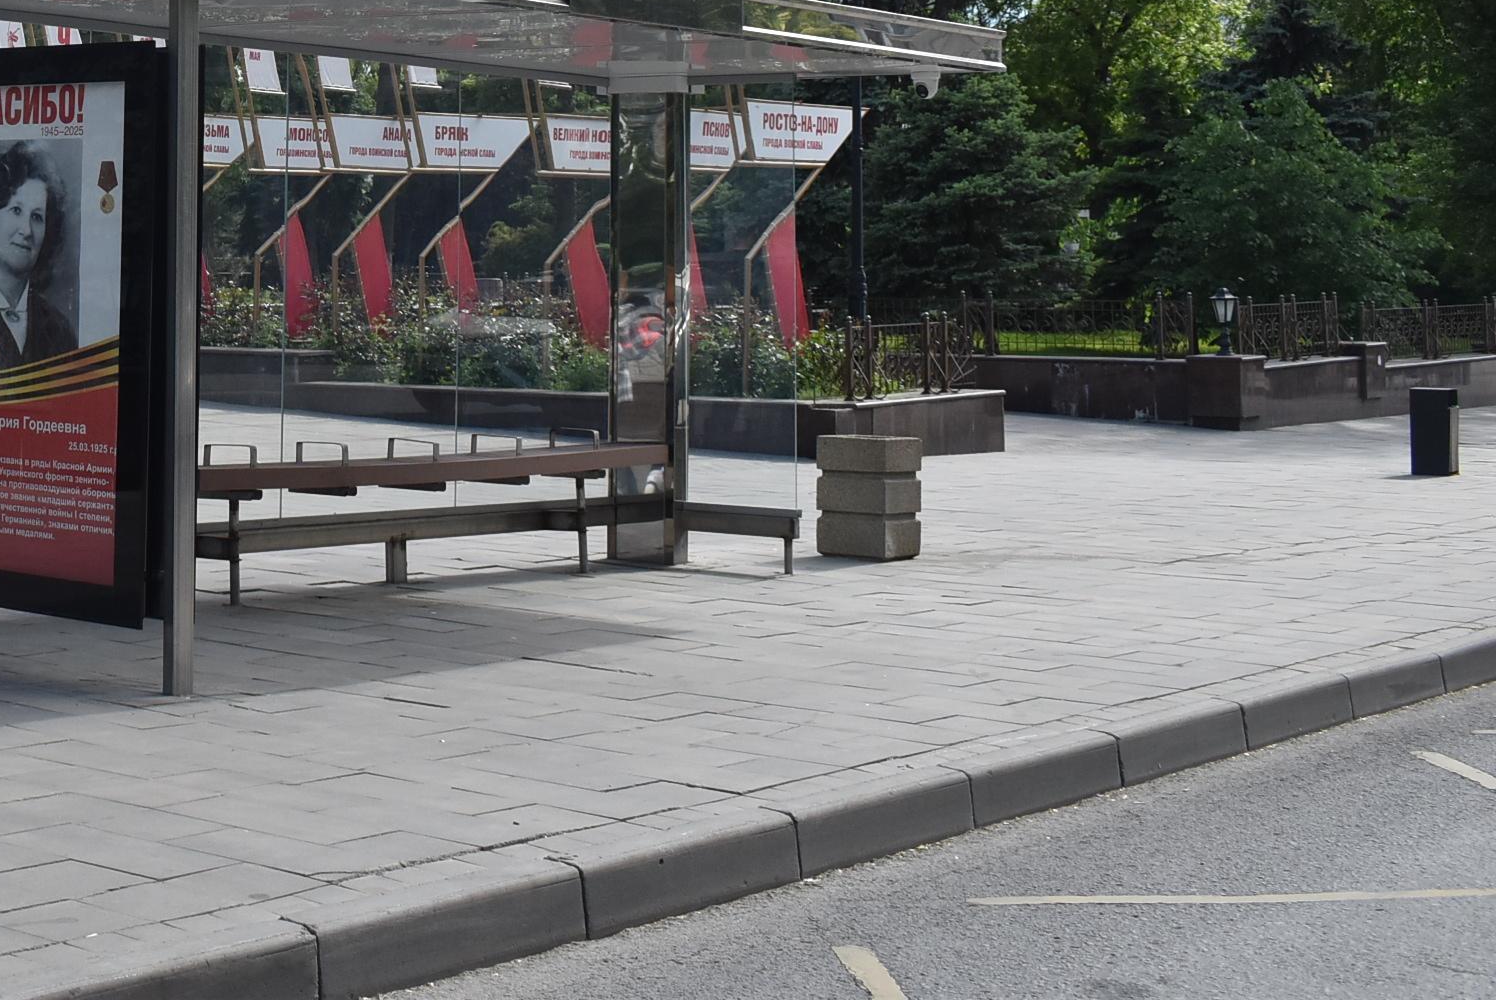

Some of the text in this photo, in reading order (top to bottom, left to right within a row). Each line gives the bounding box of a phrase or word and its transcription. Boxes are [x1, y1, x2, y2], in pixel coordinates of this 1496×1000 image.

[249, 51, 261, 61] МАЯ
[703, 121, 730, 138] ПСКОВ
[23, 416, 86, 435] Гордеевна
[31, 460, 52, 470] ряды
[52, 460, 85, 472] Красной
[45, 472, 73, 483] фронта
